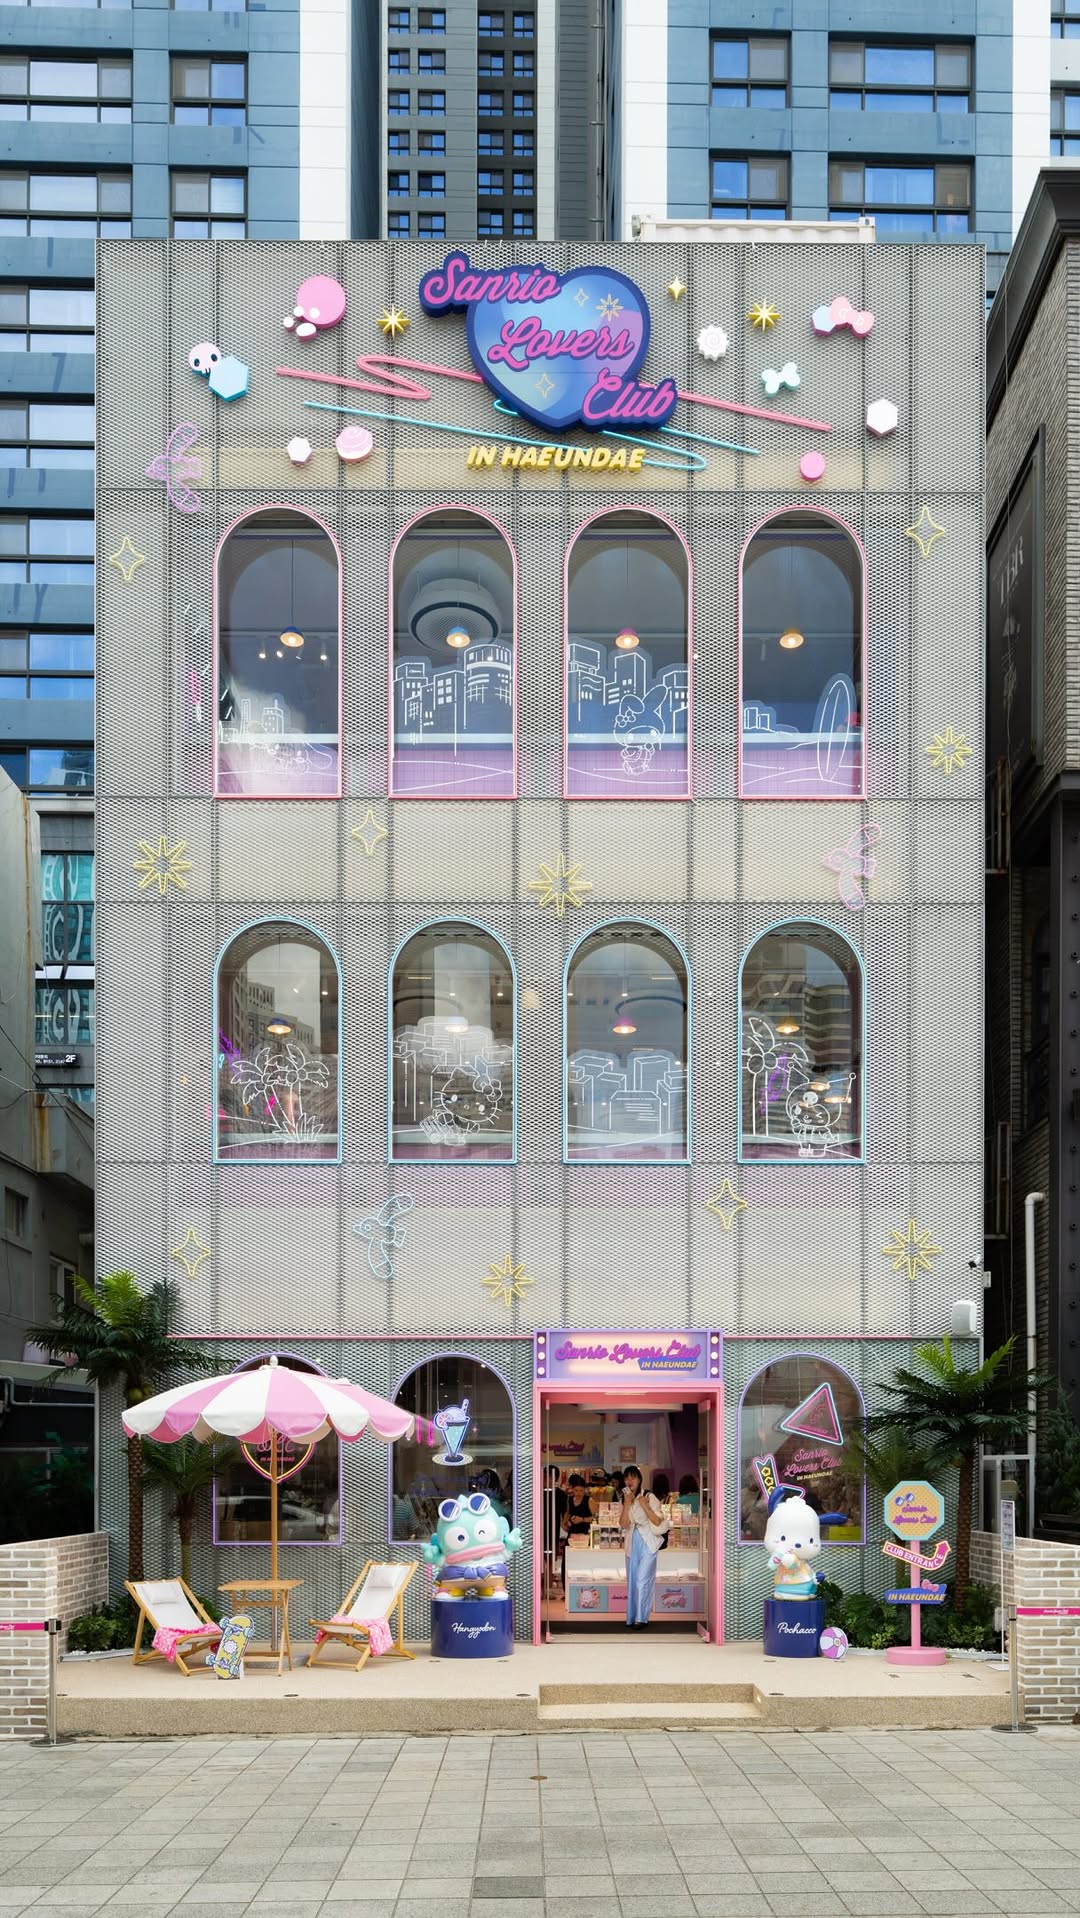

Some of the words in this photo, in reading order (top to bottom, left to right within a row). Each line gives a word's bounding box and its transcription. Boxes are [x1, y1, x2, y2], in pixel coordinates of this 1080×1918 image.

[423, 257, 561, 305] Sanrio
[487, 316, 635, 371] Lovers
[582, 368, 676, 420] Club
[467, 446, 496, 470] IN
[501, 446, 646, 473] HAEUNDAE
[65, 1054, 76, 1063] 2F
[555, 1341, 608, 1360] Sanrio
[609, 1343, 663, 1364] Lovers
[666, 1340, 701, 1359] Club
[652, 1361, 697, 1369] HAEUNDAE
[794, 1448, 829, 1462] Sanrio
[885, 1544, 904, 1557] CLUB
[903, 1553, 944, 1569] ENTRANCE
[898, 1593, 946, 1602] HAEUNDAE
[451, 1621, 497, 1639] Hangyodon
[777, 1621, 817, 1634] Pochacco
